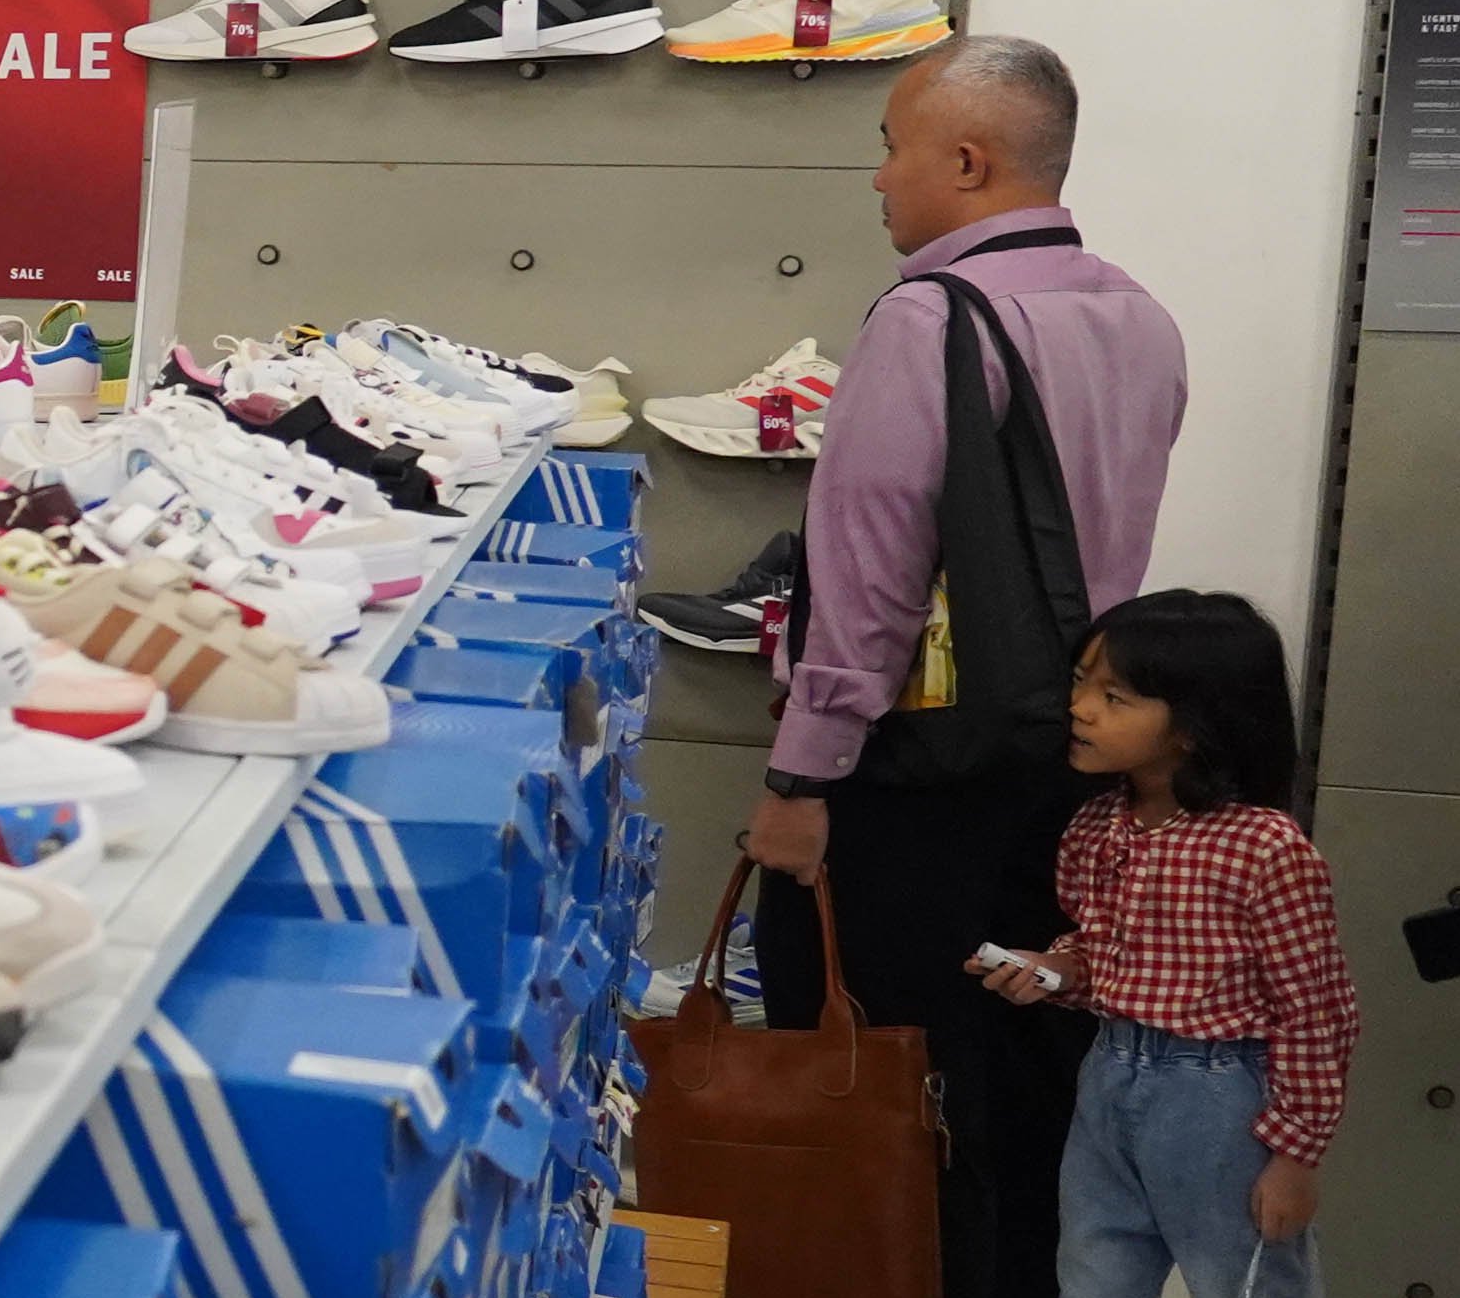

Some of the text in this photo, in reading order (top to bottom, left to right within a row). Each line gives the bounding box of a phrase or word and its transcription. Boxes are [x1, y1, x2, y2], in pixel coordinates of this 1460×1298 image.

[801, 14, 826, 27] 70%
[231, 24, 254, 36] 70%
[10, 267, 44, 280] SALE
[97, 269, 132, 282] SALE
[763, 417, 790, 430] 60%
